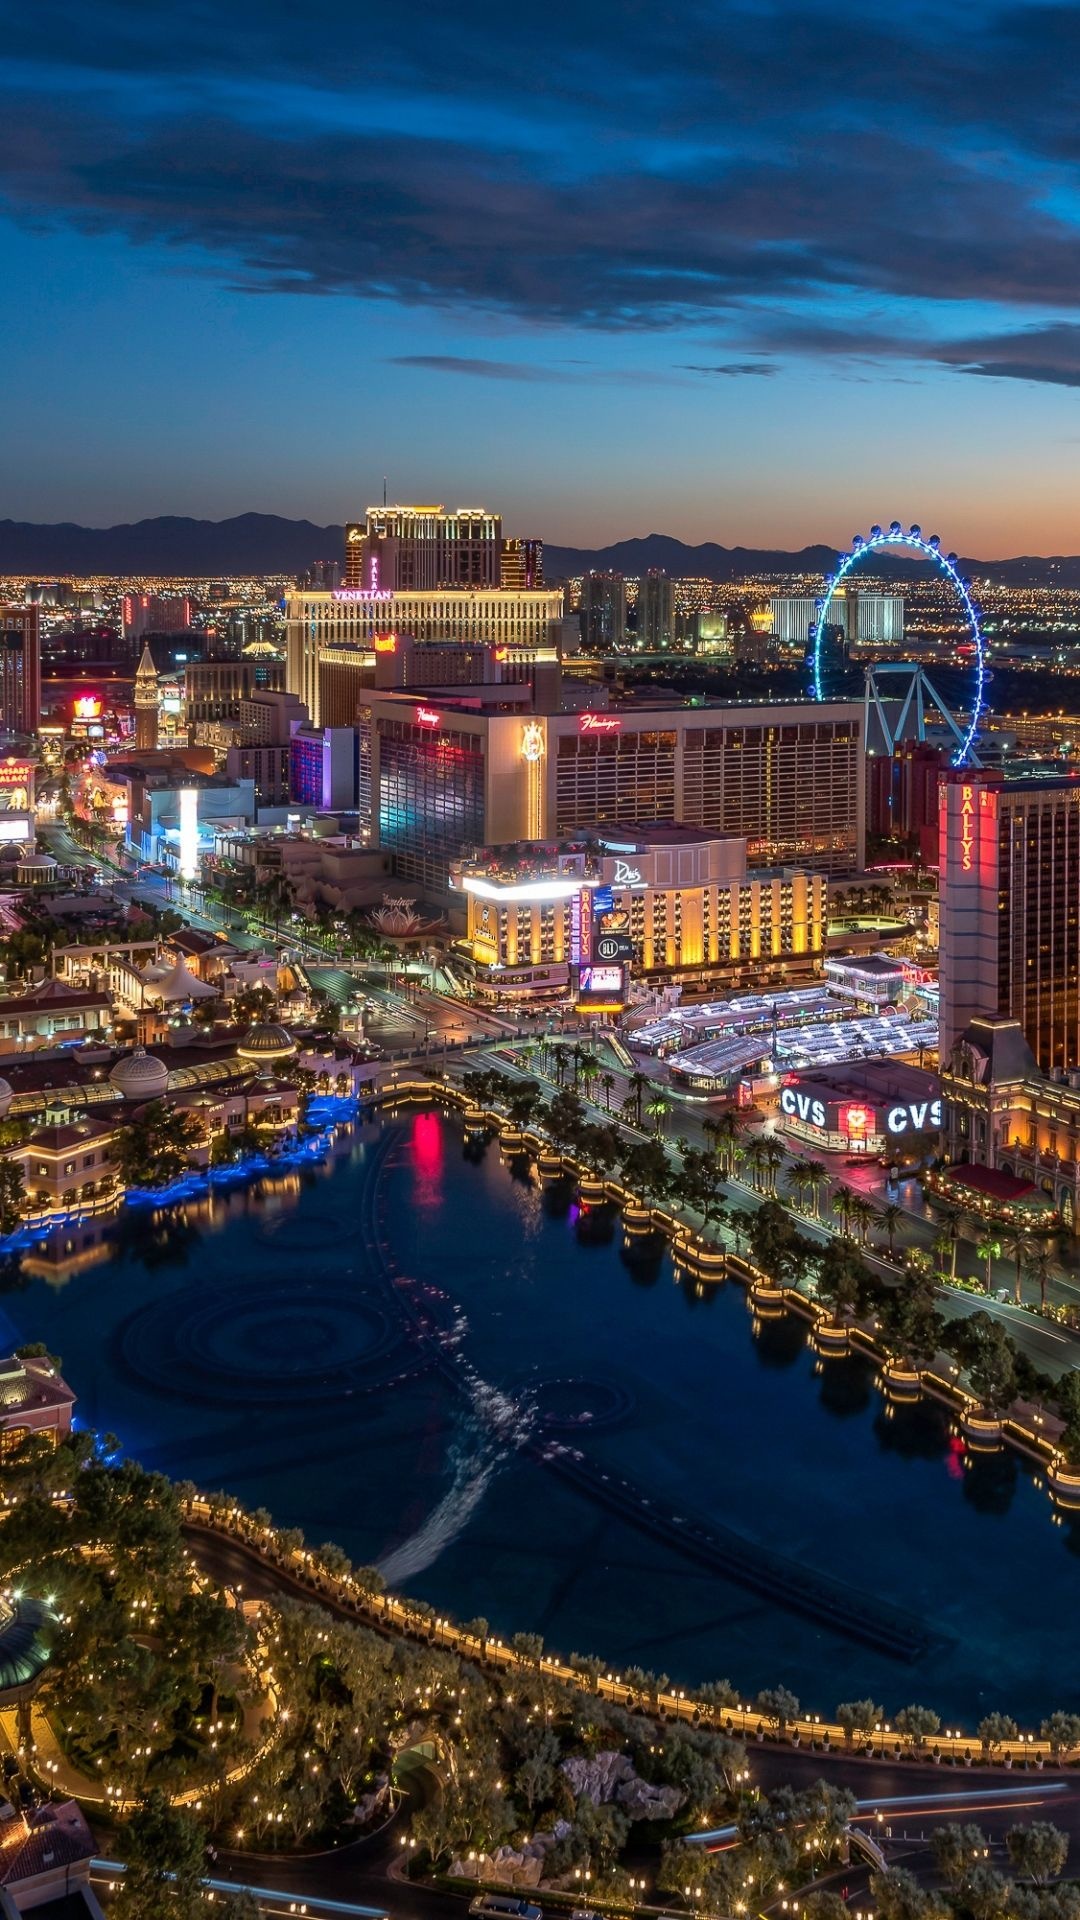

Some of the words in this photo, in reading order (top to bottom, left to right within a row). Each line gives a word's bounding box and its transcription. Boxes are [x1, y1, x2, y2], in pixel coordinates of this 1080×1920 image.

[334, 591, 391, 600] VENETIAN
[579, 714, 620, 731] Flamingo
[602, 942, 614, 955] BLT
[781, 1088, 825, 1127] CVS
[887, 1100, 941, 1133] CVS
